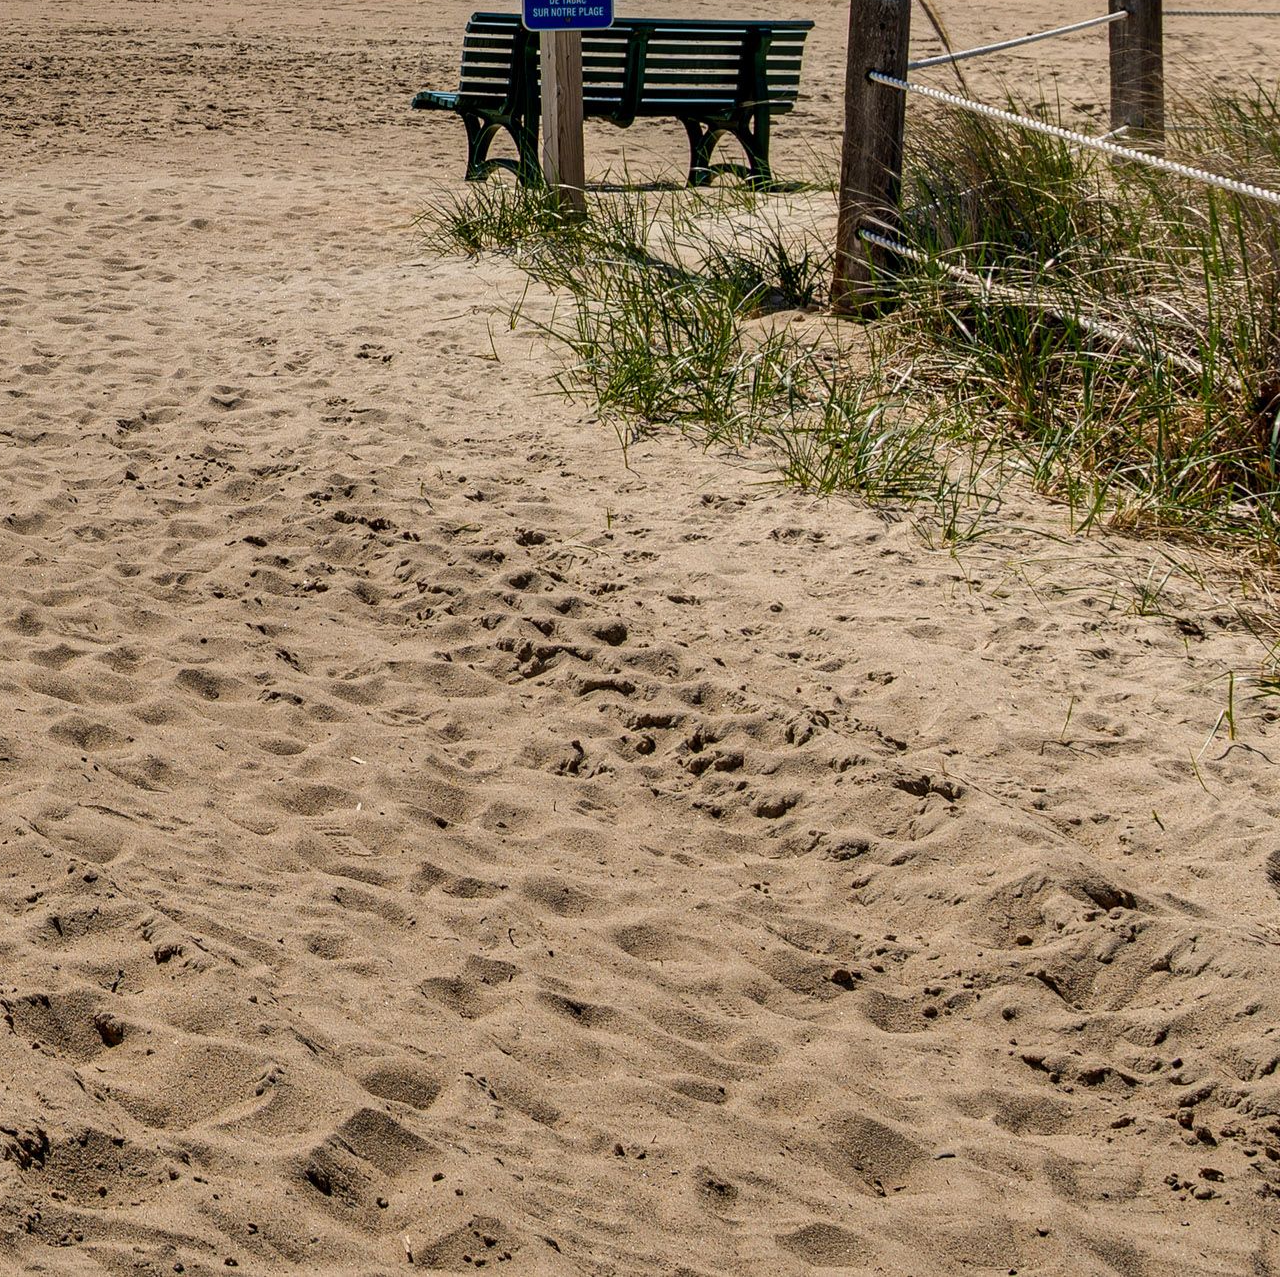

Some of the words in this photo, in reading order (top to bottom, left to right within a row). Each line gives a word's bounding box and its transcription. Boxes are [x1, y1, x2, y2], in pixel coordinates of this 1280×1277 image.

[533, 8, 548, 17] SUR
[551, 8, 576, 16] NOTRE
[580, 7, 603, 16] PLAGE
